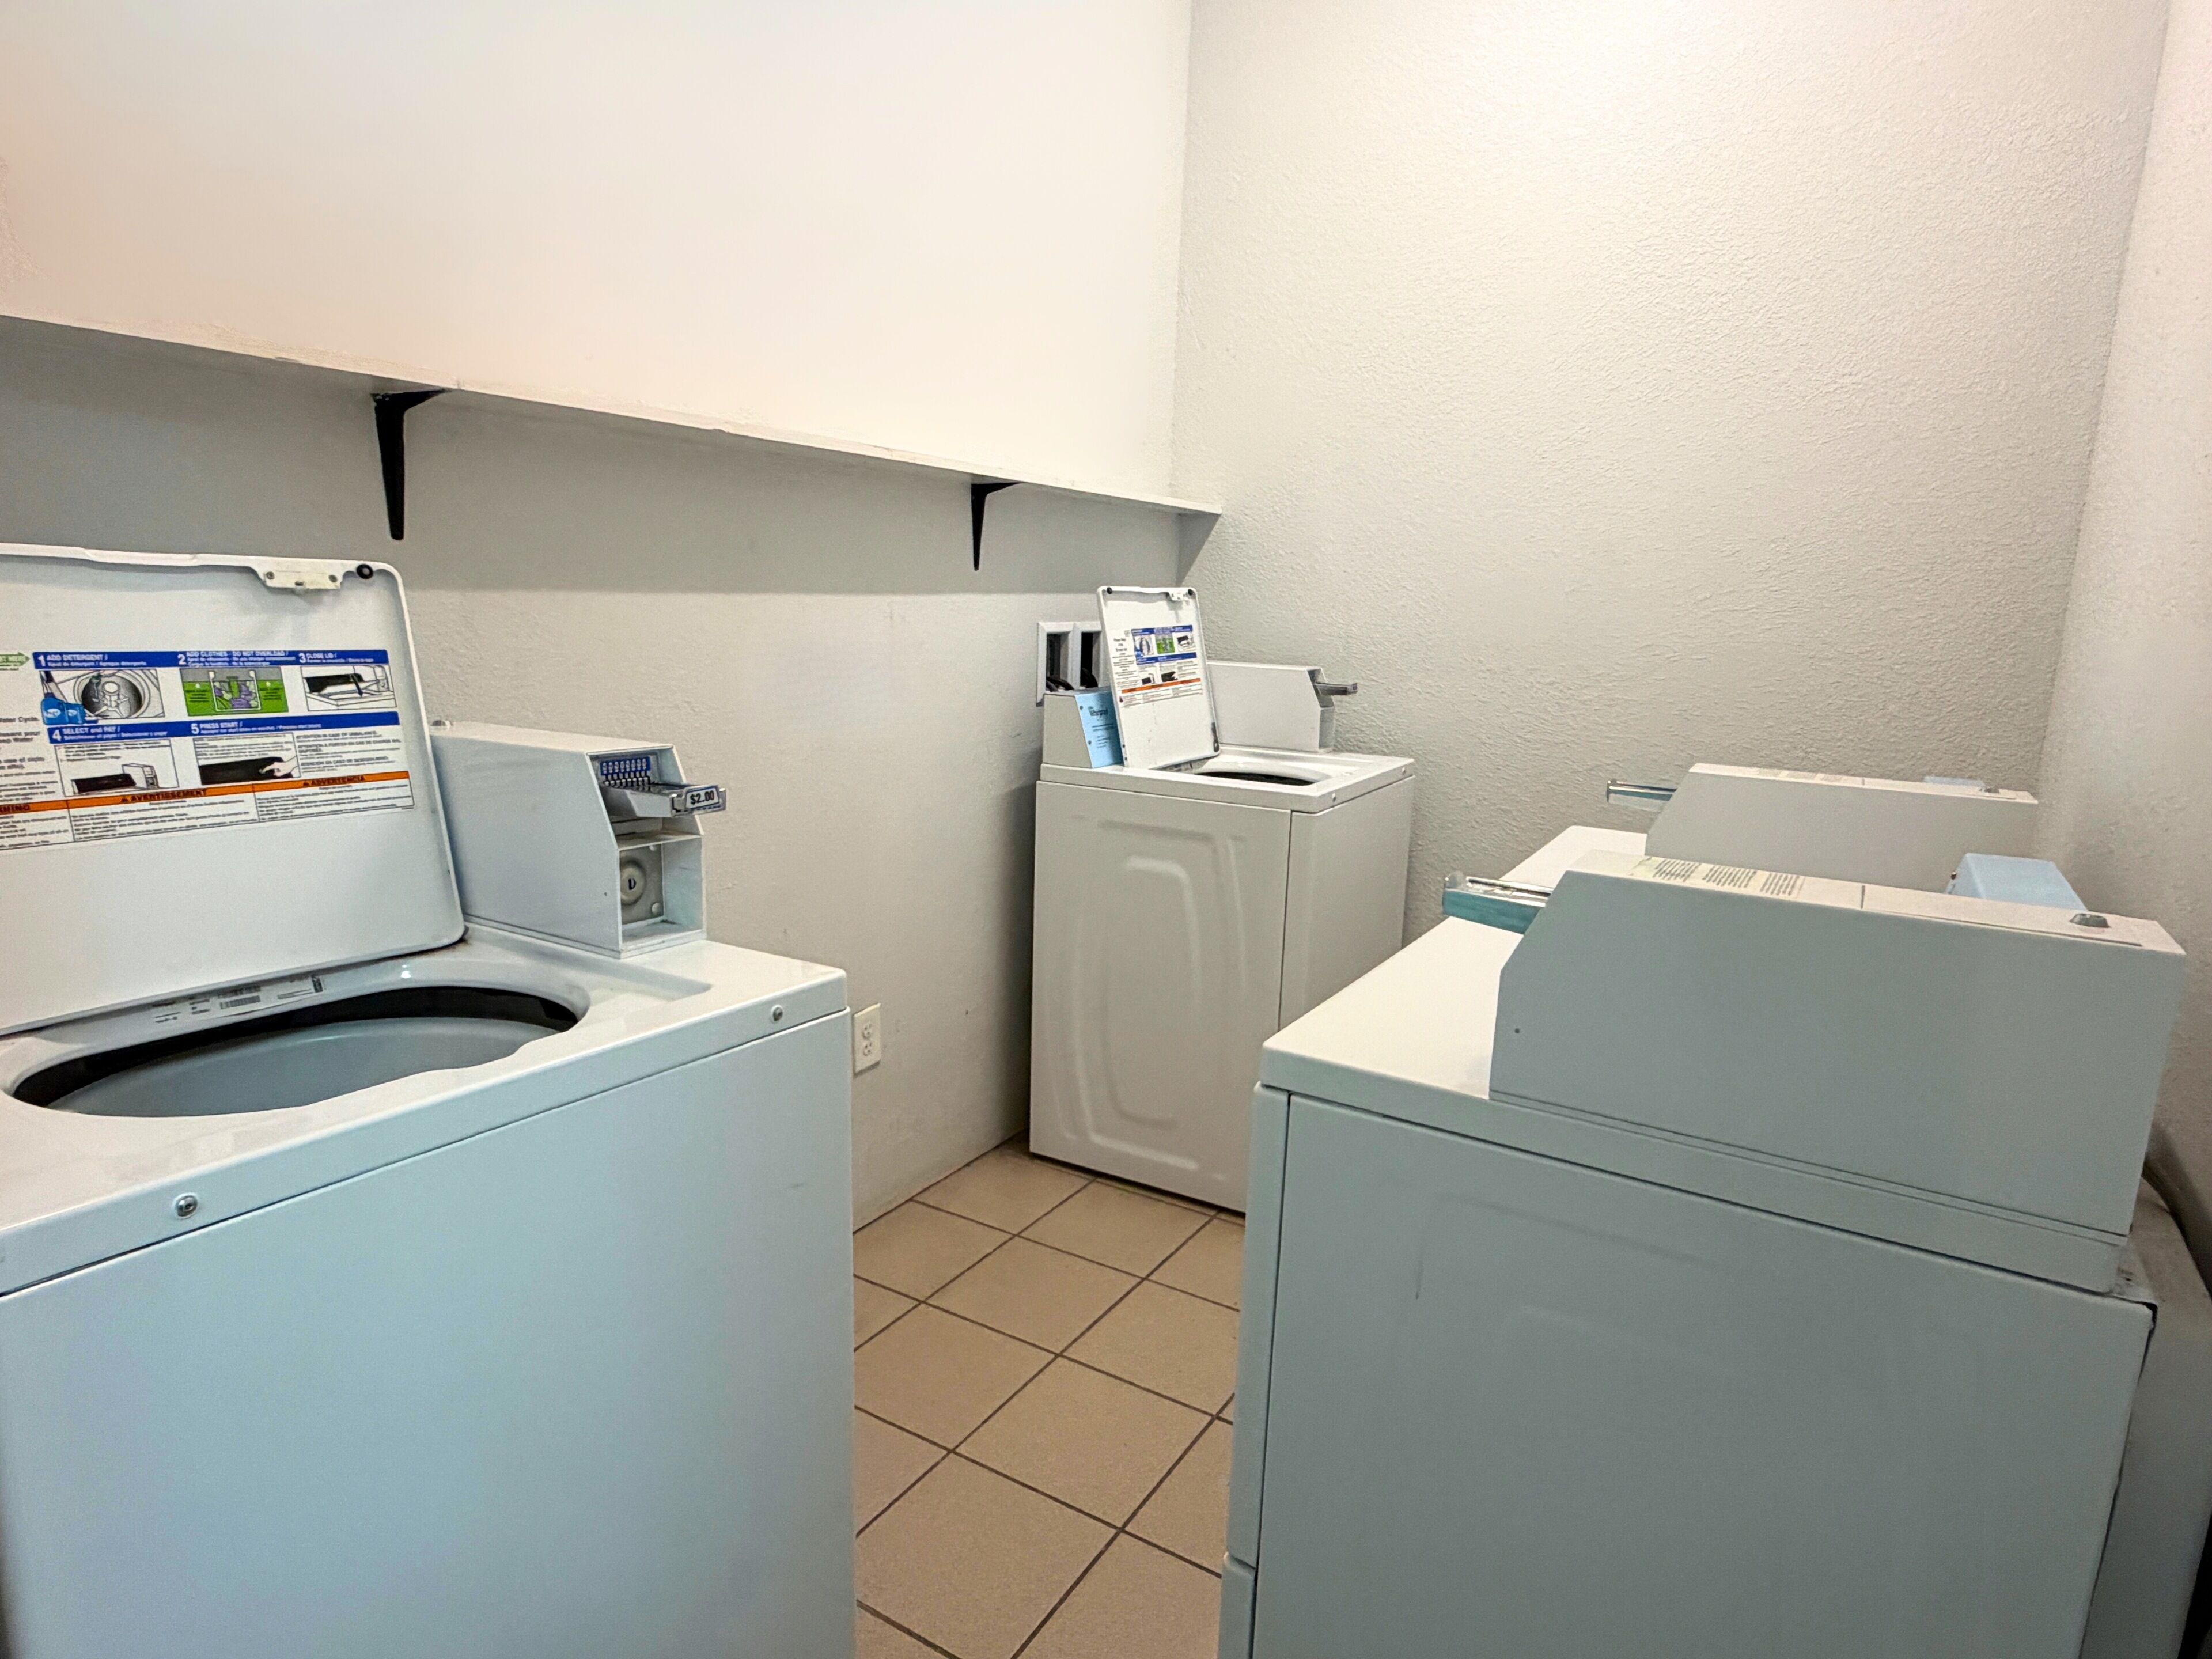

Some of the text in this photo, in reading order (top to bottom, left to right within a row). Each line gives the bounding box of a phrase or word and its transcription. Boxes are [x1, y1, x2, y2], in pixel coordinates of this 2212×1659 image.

[37, 654, 46, 667] 1
[177, 654, 187, 665] 2
[298, 653, 306, 663] 3
[191, 723, 199, 734] 5
[52, 729, 62, 741] 4
[311, 775, 365, 785] ADVERTENCIA
[131, 790, 207, 802] AVERTISSEMENT
[690, 790, 714, 805] $2.00
